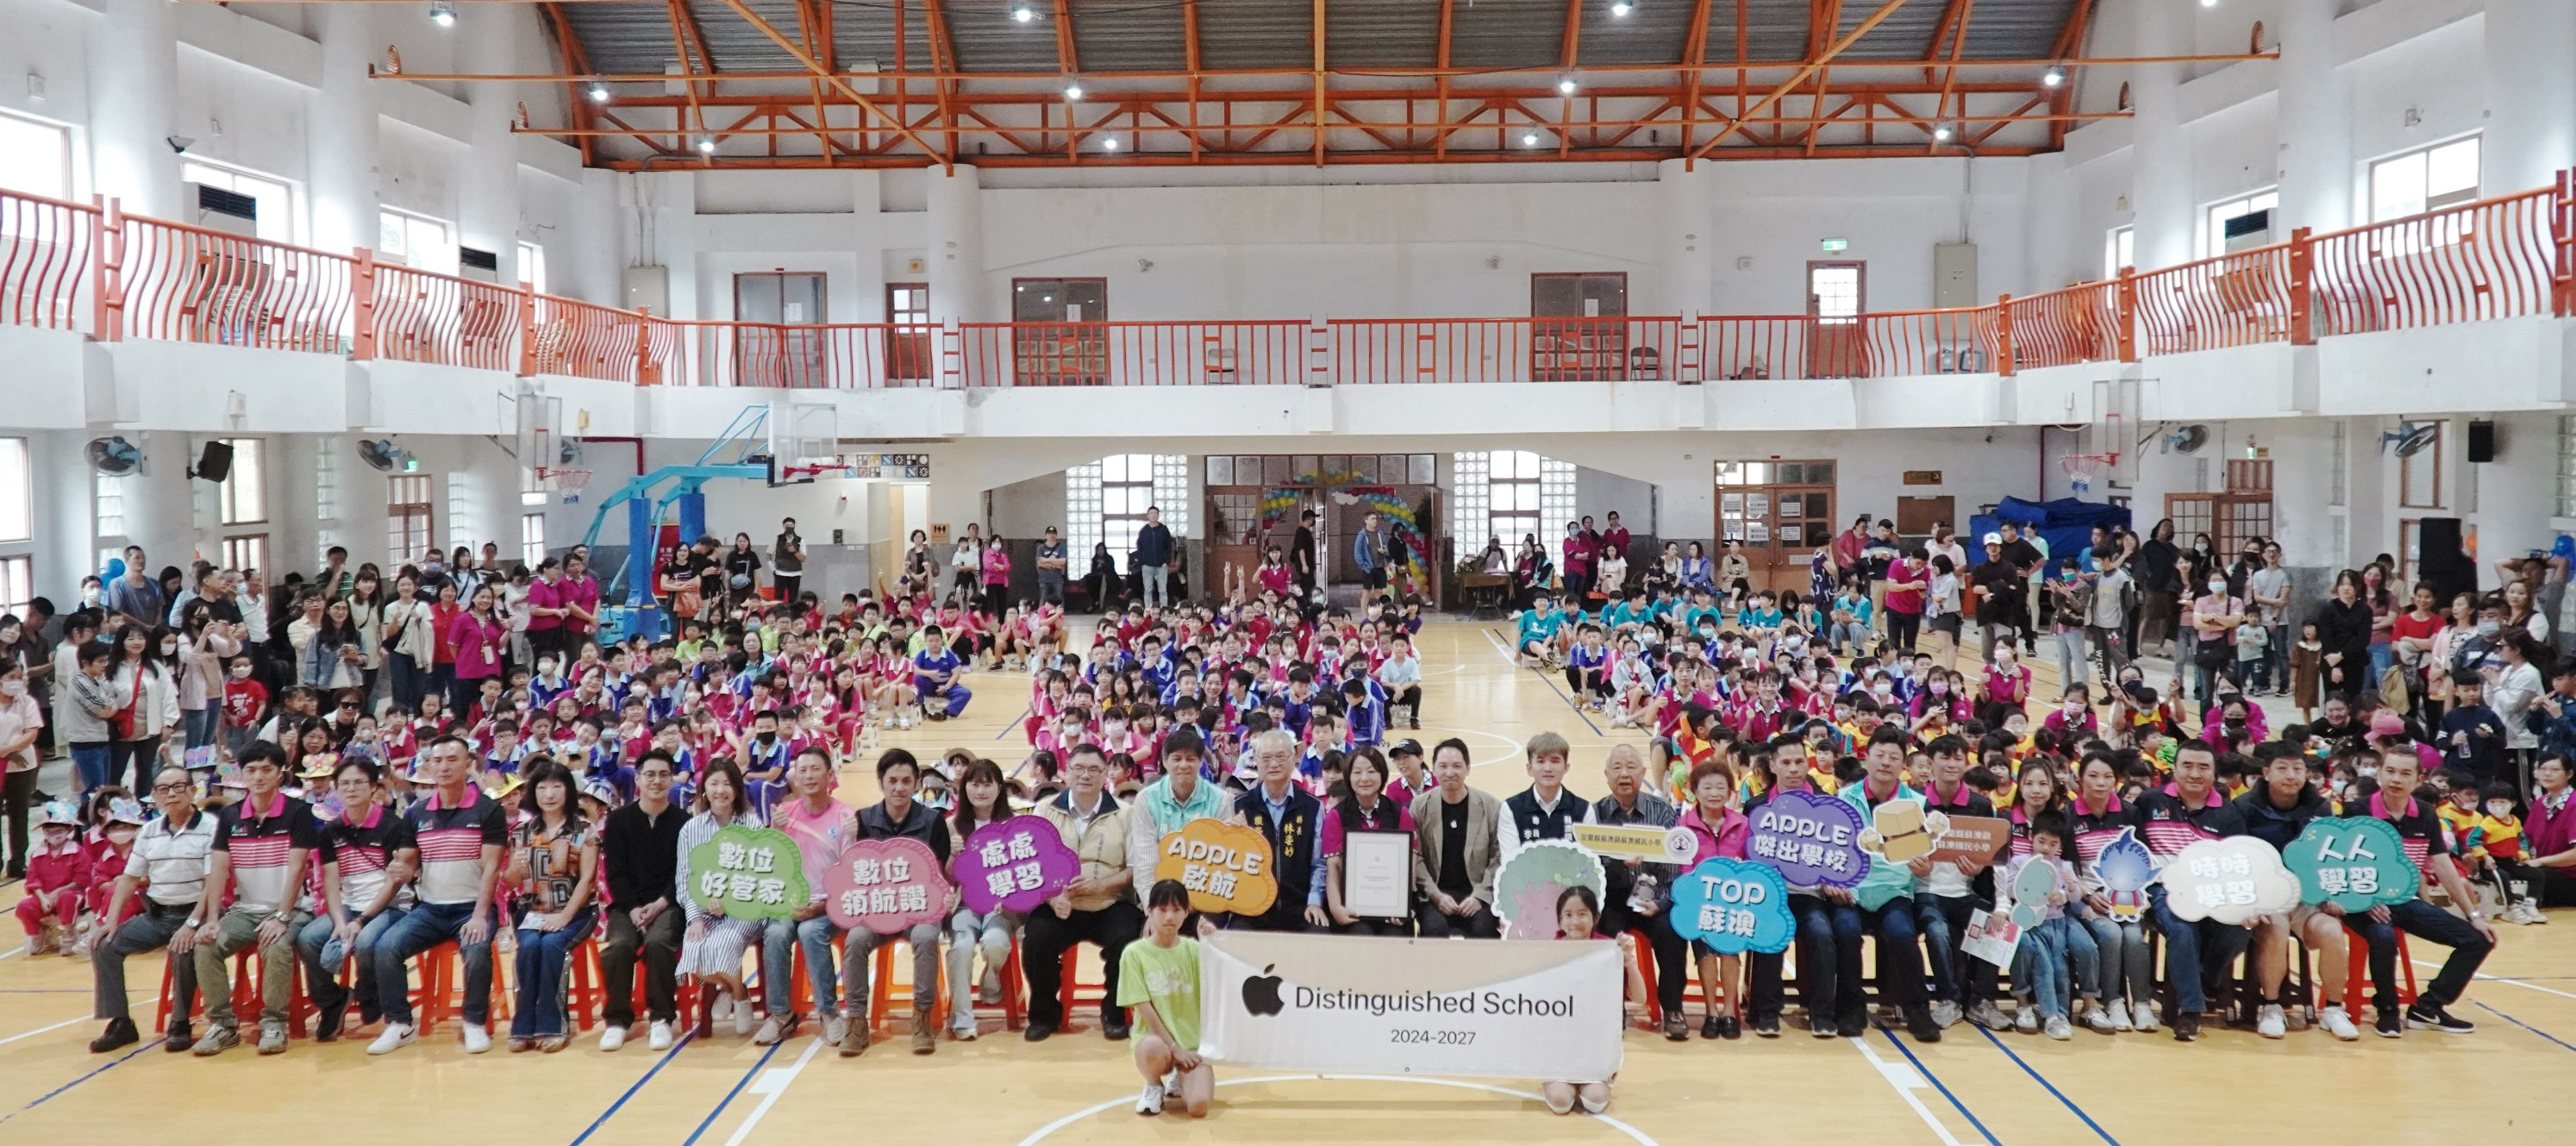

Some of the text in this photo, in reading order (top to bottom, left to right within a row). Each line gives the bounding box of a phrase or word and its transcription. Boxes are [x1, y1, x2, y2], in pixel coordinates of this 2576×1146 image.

[1760, 812, 1851, 846] APPLE
[718, 842, 773, 873] 數位
[979, 831, 1037, 867] 處處
[1167, 836, 1263, 874] APPLE
[1754, 835, 1848, 872] 傑出學校
[2317, 834, 2377, 861] 人人
[853, 857, 910, 886] 數位
[986, 862, 1044, 898] 學習
[2190, 853, 2251, 879] 時時
[2318, 867, 2379, 895] 學習
[701, 871, 786, 904] 好管家
[841, 884, 928, 916] 領航讚
[1701, 876, 1766, 905] TOP
[2194, 880, 2257, 907] 學習
[1698, 905, 1755, 937] 蘇澳
[1295, 986, 1573, 1018] Distinguished School
[1391, 1030, 1476, 1045] 2024-2027
